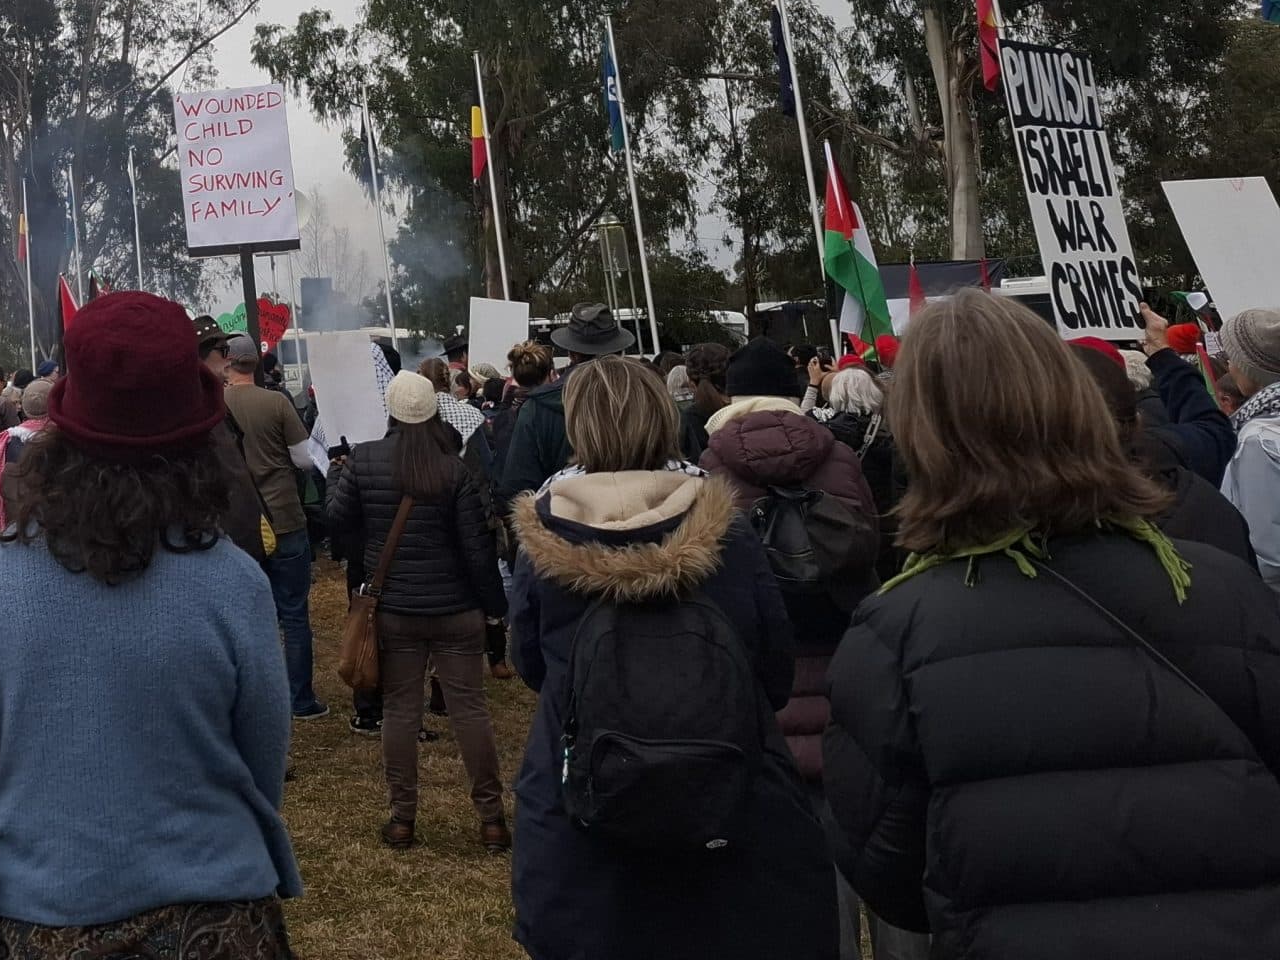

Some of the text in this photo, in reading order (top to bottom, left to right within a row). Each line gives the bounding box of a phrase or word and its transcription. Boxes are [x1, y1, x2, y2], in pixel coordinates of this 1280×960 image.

[1001, 46, 1103, 129] PUNISH
[184, 119, 253, 141] CHILD
[188, 147, 223, 167] NO
[188, 169, 284, 194] SURVIVING
[1017, 127, 1113, 197] ISRAELI
[1046, 198, 1117, 253] WAR
[1051, 255, 1146, 330] CRIMES
